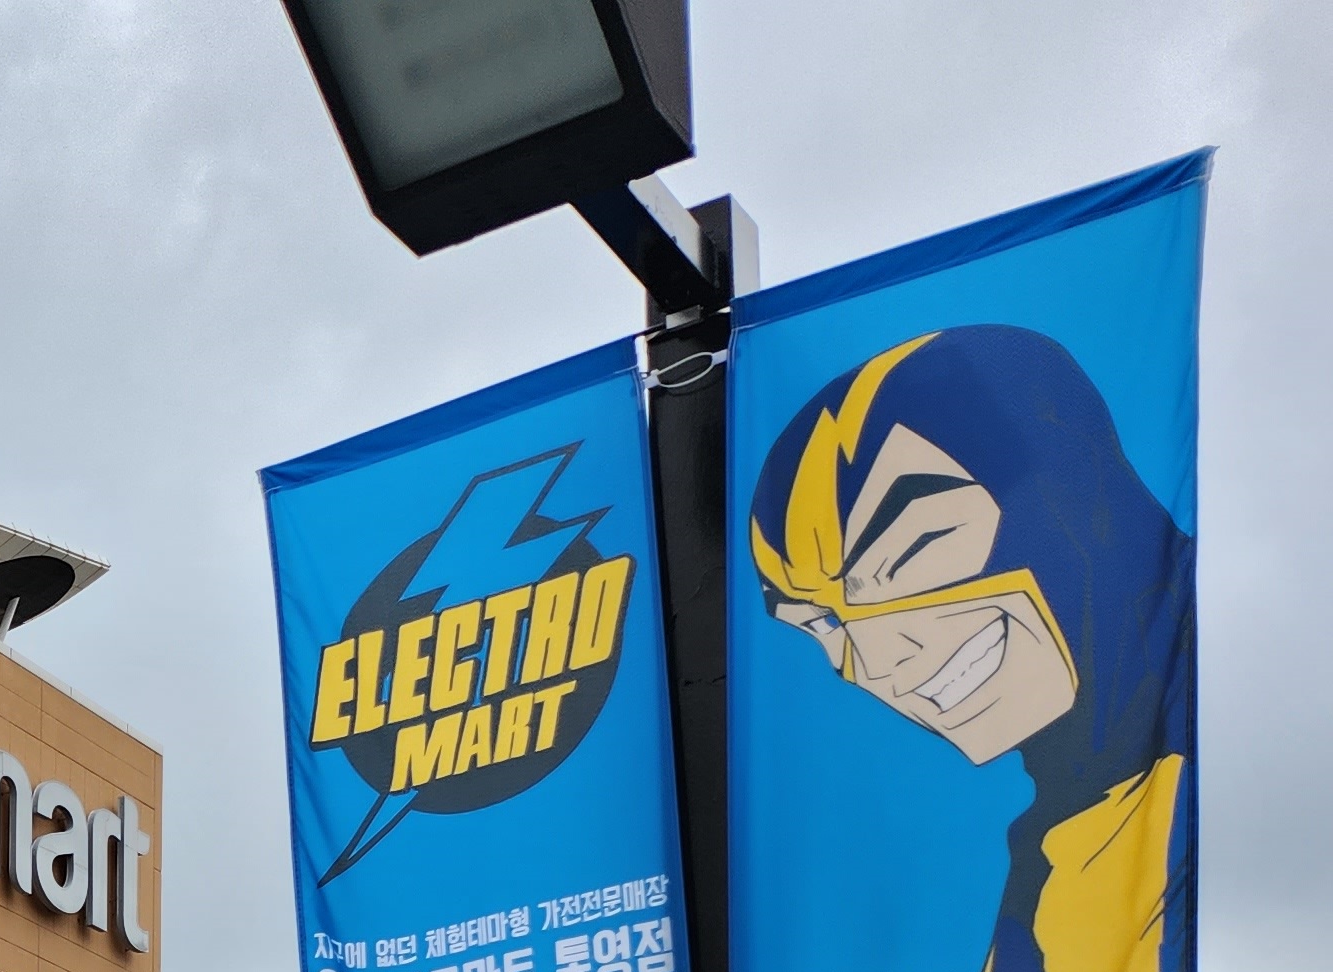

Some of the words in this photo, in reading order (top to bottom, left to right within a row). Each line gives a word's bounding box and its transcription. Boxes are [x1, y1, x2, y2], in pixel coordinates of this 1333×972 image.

[310, 556, 632, 744] ELECTRO
[389, 680, 577, 793] MART
[314, 931, 367, 969] 지구에
[376, 935, 417, 968] 없던
[425, 906, 530, 959] 체험테마형
[538, 875, 670, 931] 가전전문매장
